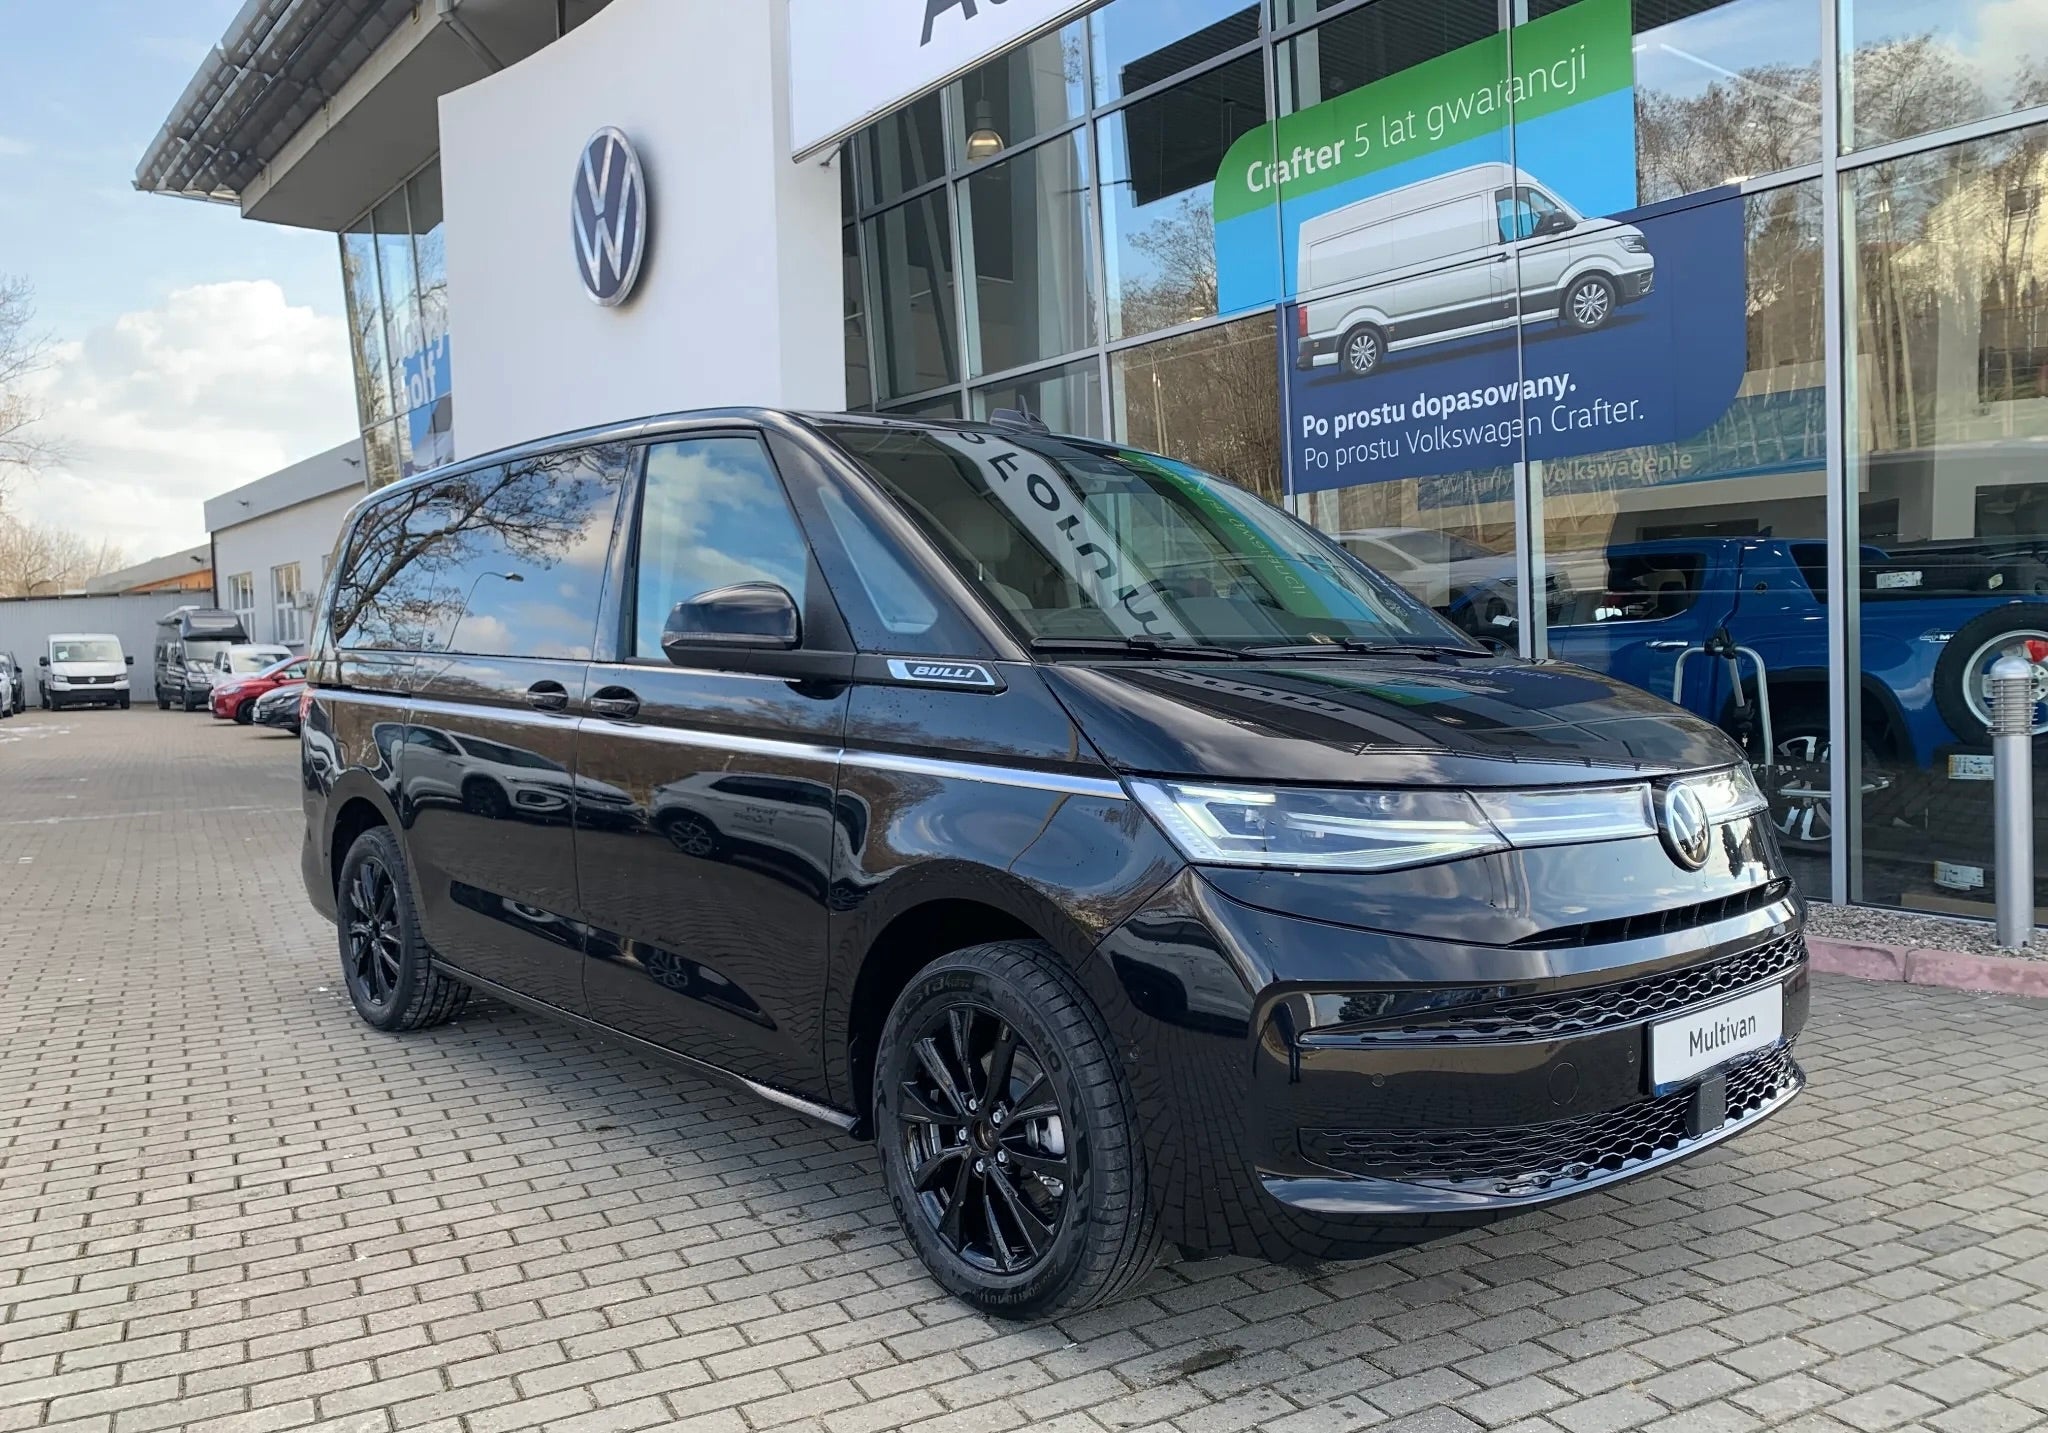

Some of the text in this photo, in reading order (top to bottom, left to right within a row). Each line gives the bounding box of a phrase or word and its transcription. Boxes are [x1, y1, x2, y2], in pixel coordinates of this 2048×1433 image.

[1246, 44, 1587, 192] Crafter 5 lat gwarancji
[1303, 372, 1577, 439] Po prostu dopasowany.
[1304, 398, 1645, 472] Po prostu Volkswagen Crafter.
[1542, 451, 1693, 484] Volkswagenie
[1689, 1015, 1757, 1057] Multivan
